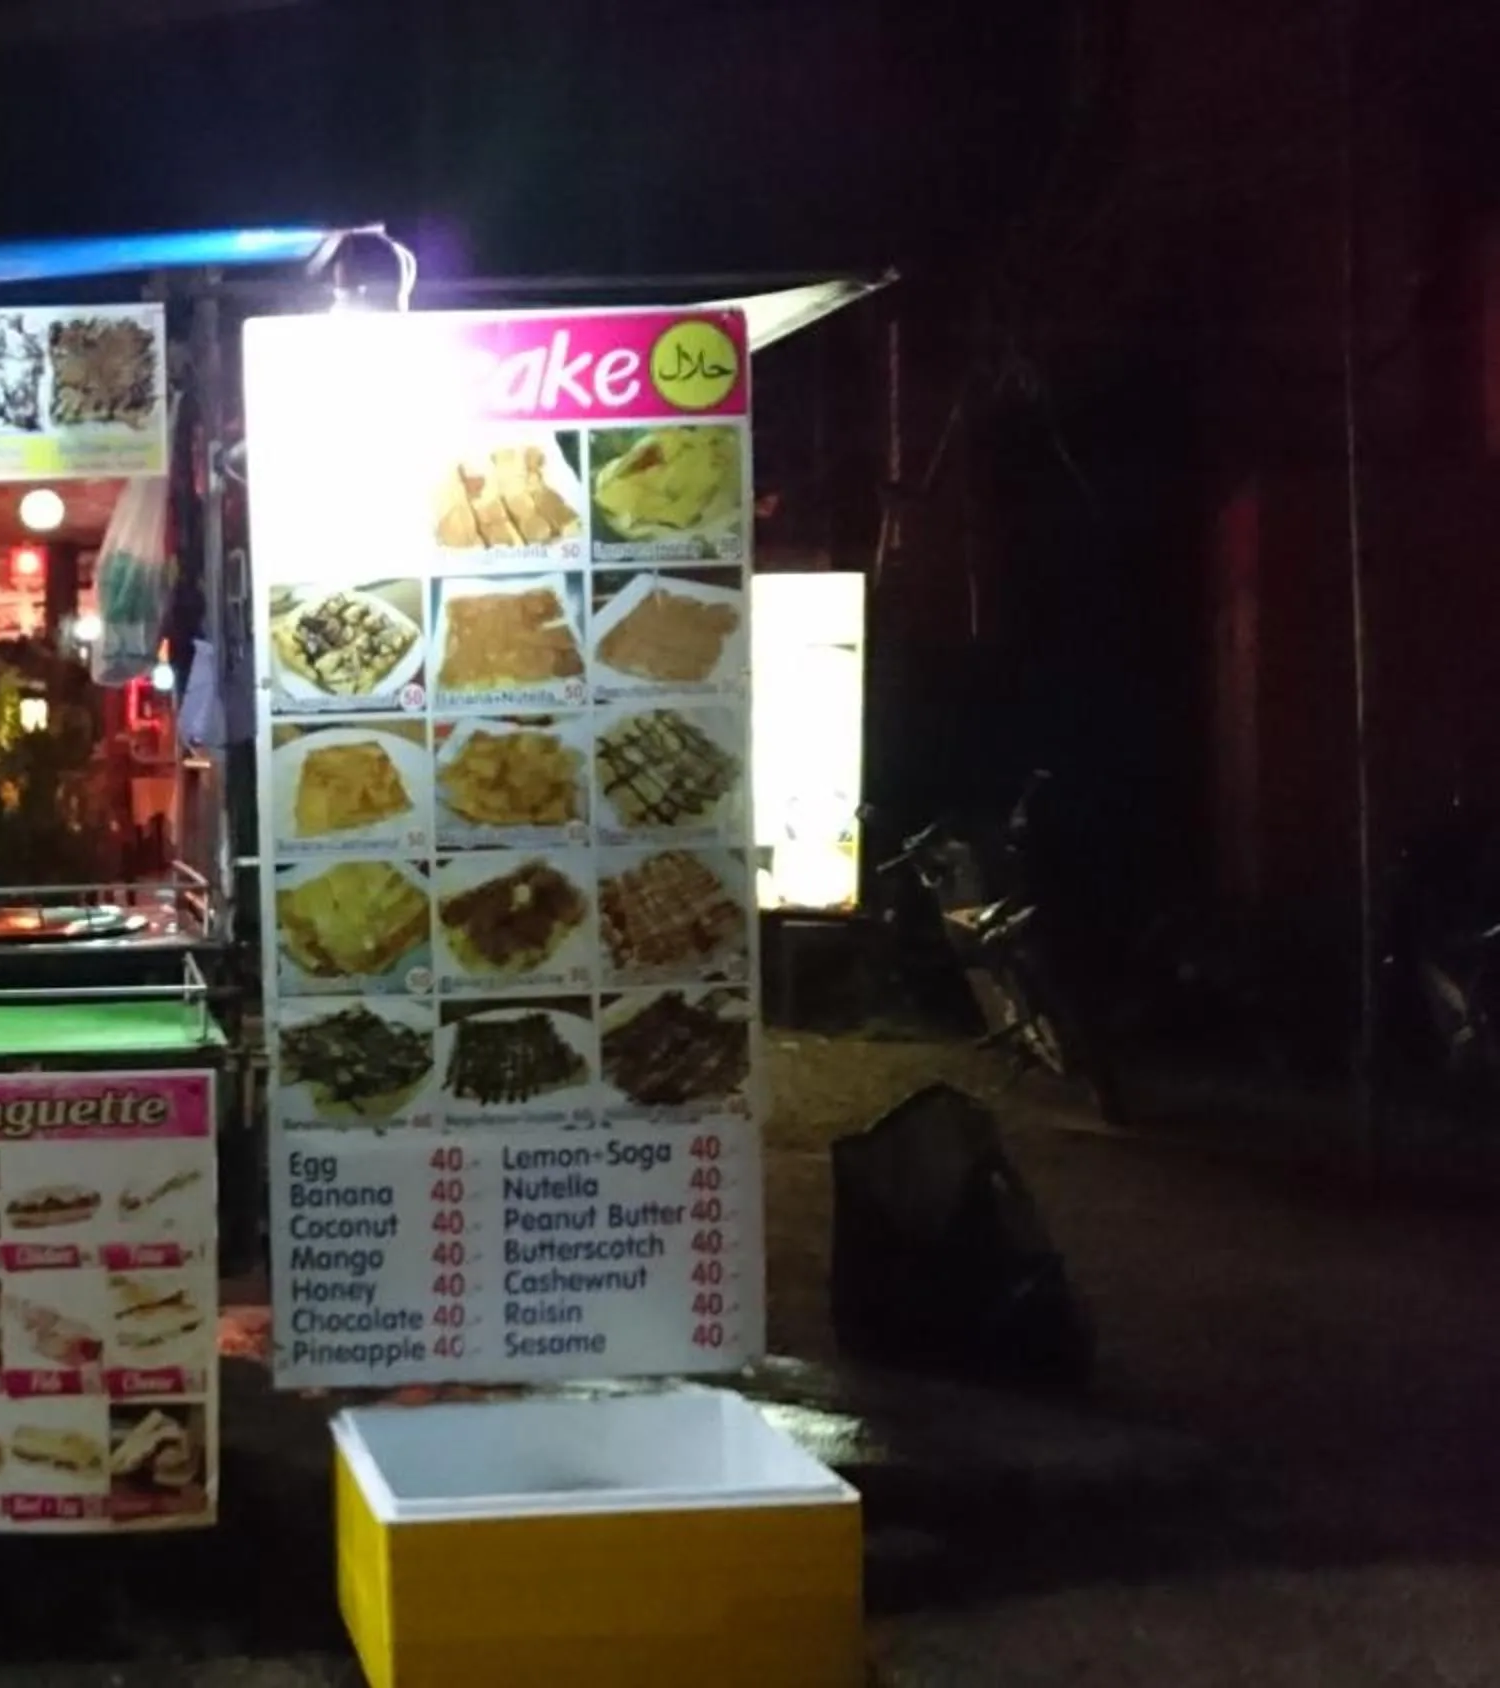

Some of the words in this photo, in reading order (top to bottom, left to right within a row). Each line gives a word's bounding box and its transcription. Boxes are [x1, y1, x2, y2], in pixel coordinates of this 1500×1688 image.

[289, 1150, 338, 1182] Egg
[290, 1183, 394, 1208] Banana
[503, 1174, 599, 1200] Nutella
[290, 1213, 398, 1240] Coconut
[504, 1205, 597, 1232] Peanut
[607, 1203, 687, 1228] Butter
[290, 1246, 384, 1276] Mango
[504, 1235, 665, 1264] Butterscotch
[291, 1278, 376, 1307] Honey
[504, 1267, 648, 1296] Cashewnut
[291, 1308, 424, 1333] Chocolate
[504, 1300, 583, 1325] Raisin
[292, 1338, 426, 1370] Pineapple
[505, 1331, 607, 1358] Sesame
